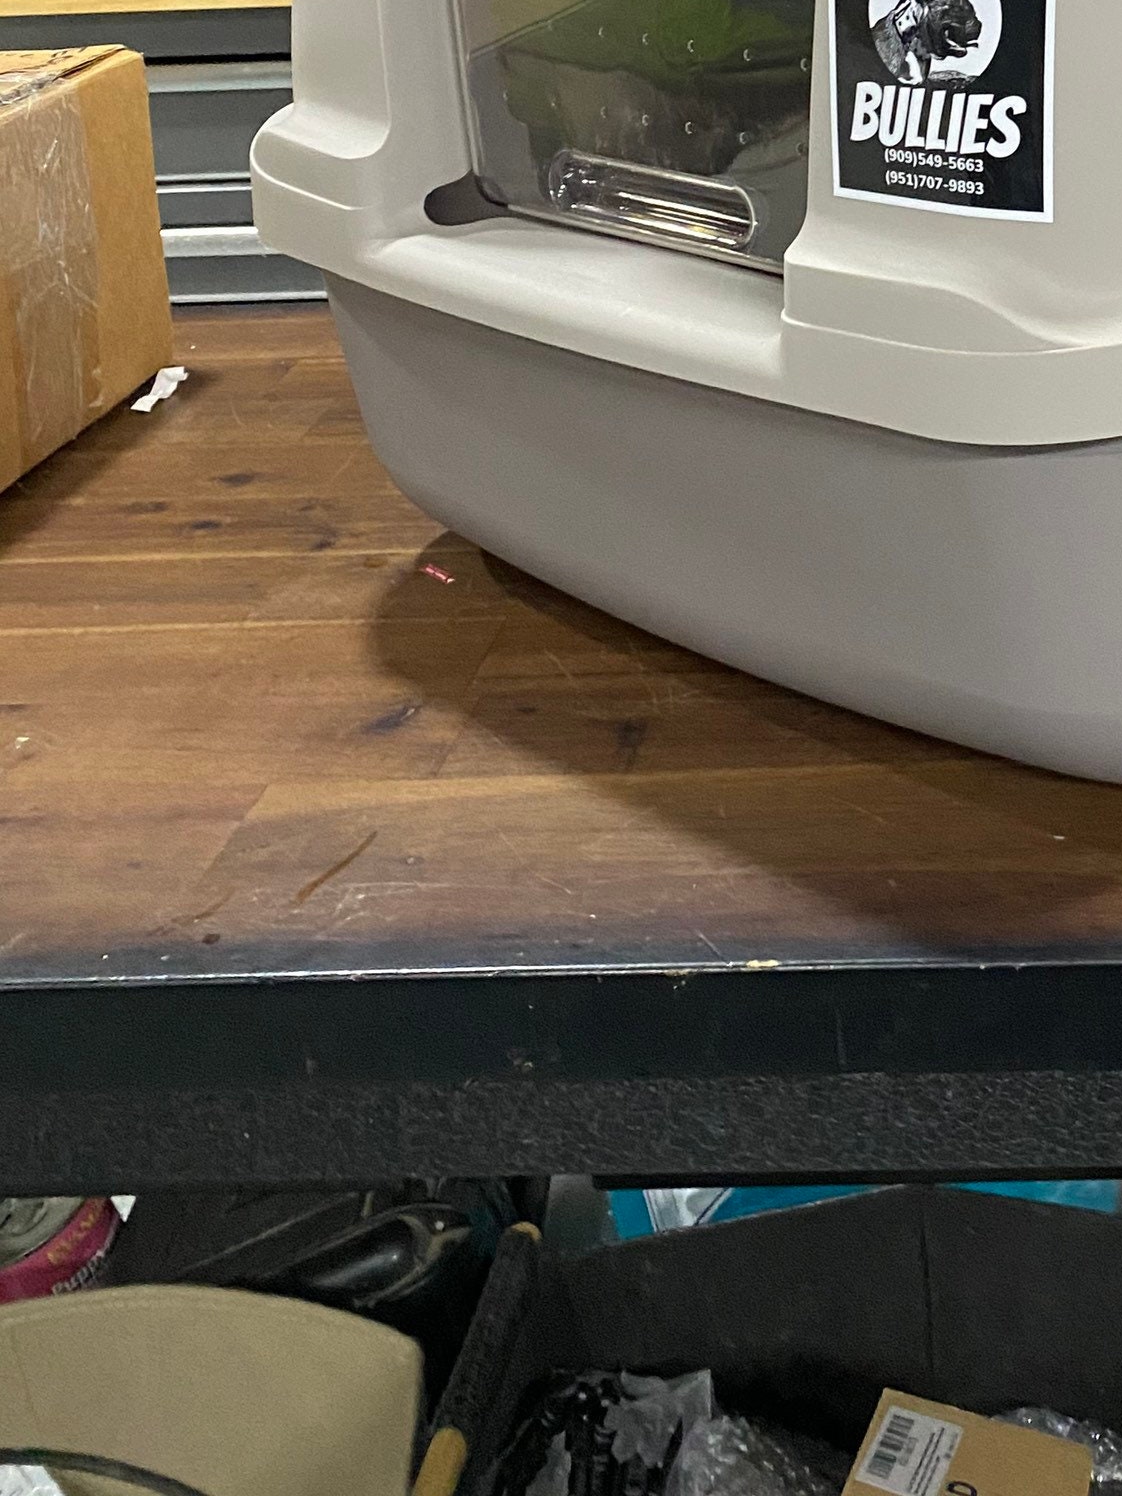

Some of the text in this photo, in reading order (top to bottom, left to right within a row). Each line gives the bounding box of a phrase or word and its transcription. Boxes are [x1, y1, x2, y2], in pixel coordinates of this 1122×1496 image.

[850, 81, 1027, 158] BULLIES
[884, 148, 984, 173] (909)549-5663
[885, 170, 985, 195] (951)707-9893
